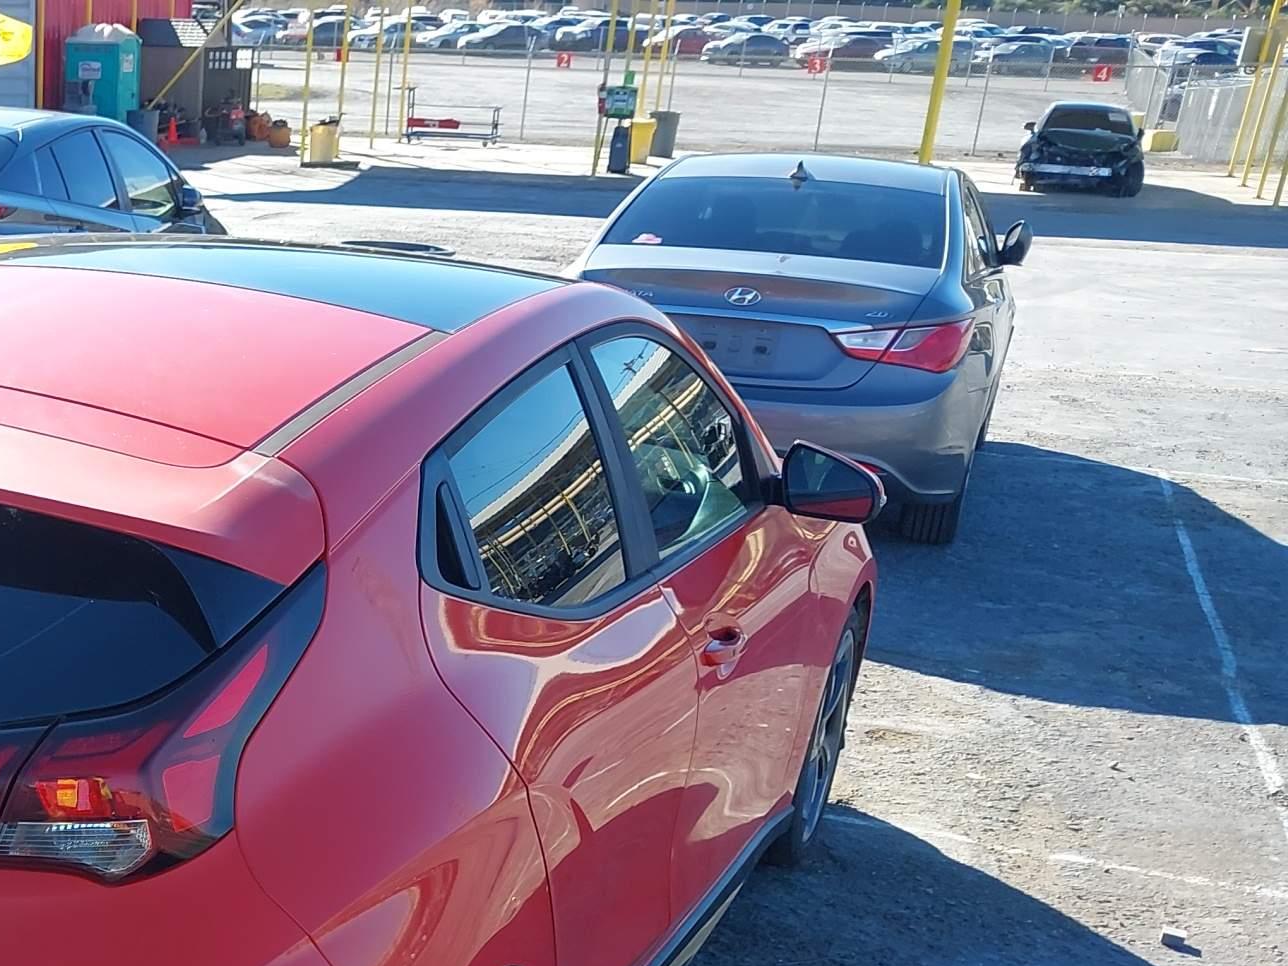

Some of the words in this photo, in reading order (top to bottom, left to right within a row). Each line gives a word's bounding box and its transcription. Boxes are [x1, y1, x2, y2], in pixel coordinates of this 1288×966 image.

[560, 54, 568, 67] 2
[812, 59, 821, 73] 3
[1097, 66, 1108, 81] 4
